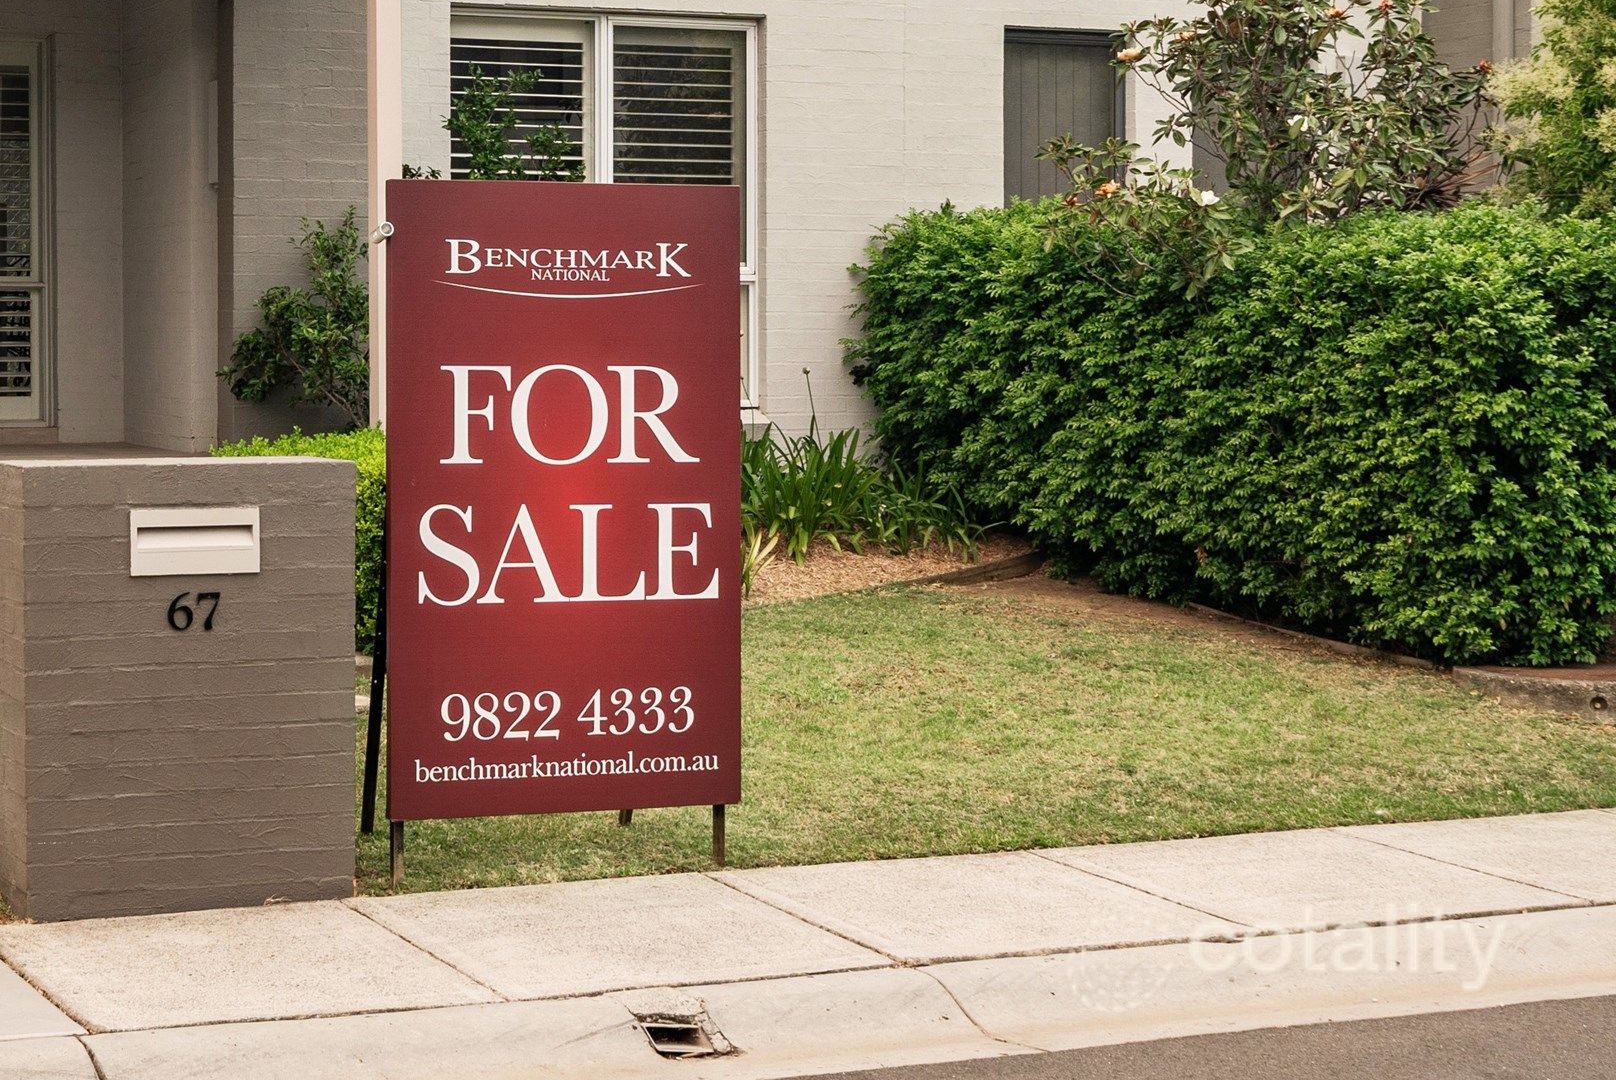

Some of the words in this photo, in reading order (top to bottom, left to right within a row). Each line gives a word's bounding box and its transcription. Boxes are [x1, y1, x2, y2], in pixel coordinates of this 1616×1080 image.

[445, 239, 692, 278] BENCHMARK
[531, 268, 610, 281] NATIONAL
[439, 364, 700, 465] FOR
[418, 503, 719, 606] SALE
[167, 592, 221, 631] 67
[440, 690, 562, 742] 9822
[577, 686, 695, 736] 4333
[415, 751, 719, 783] benchmarknational.com.au
